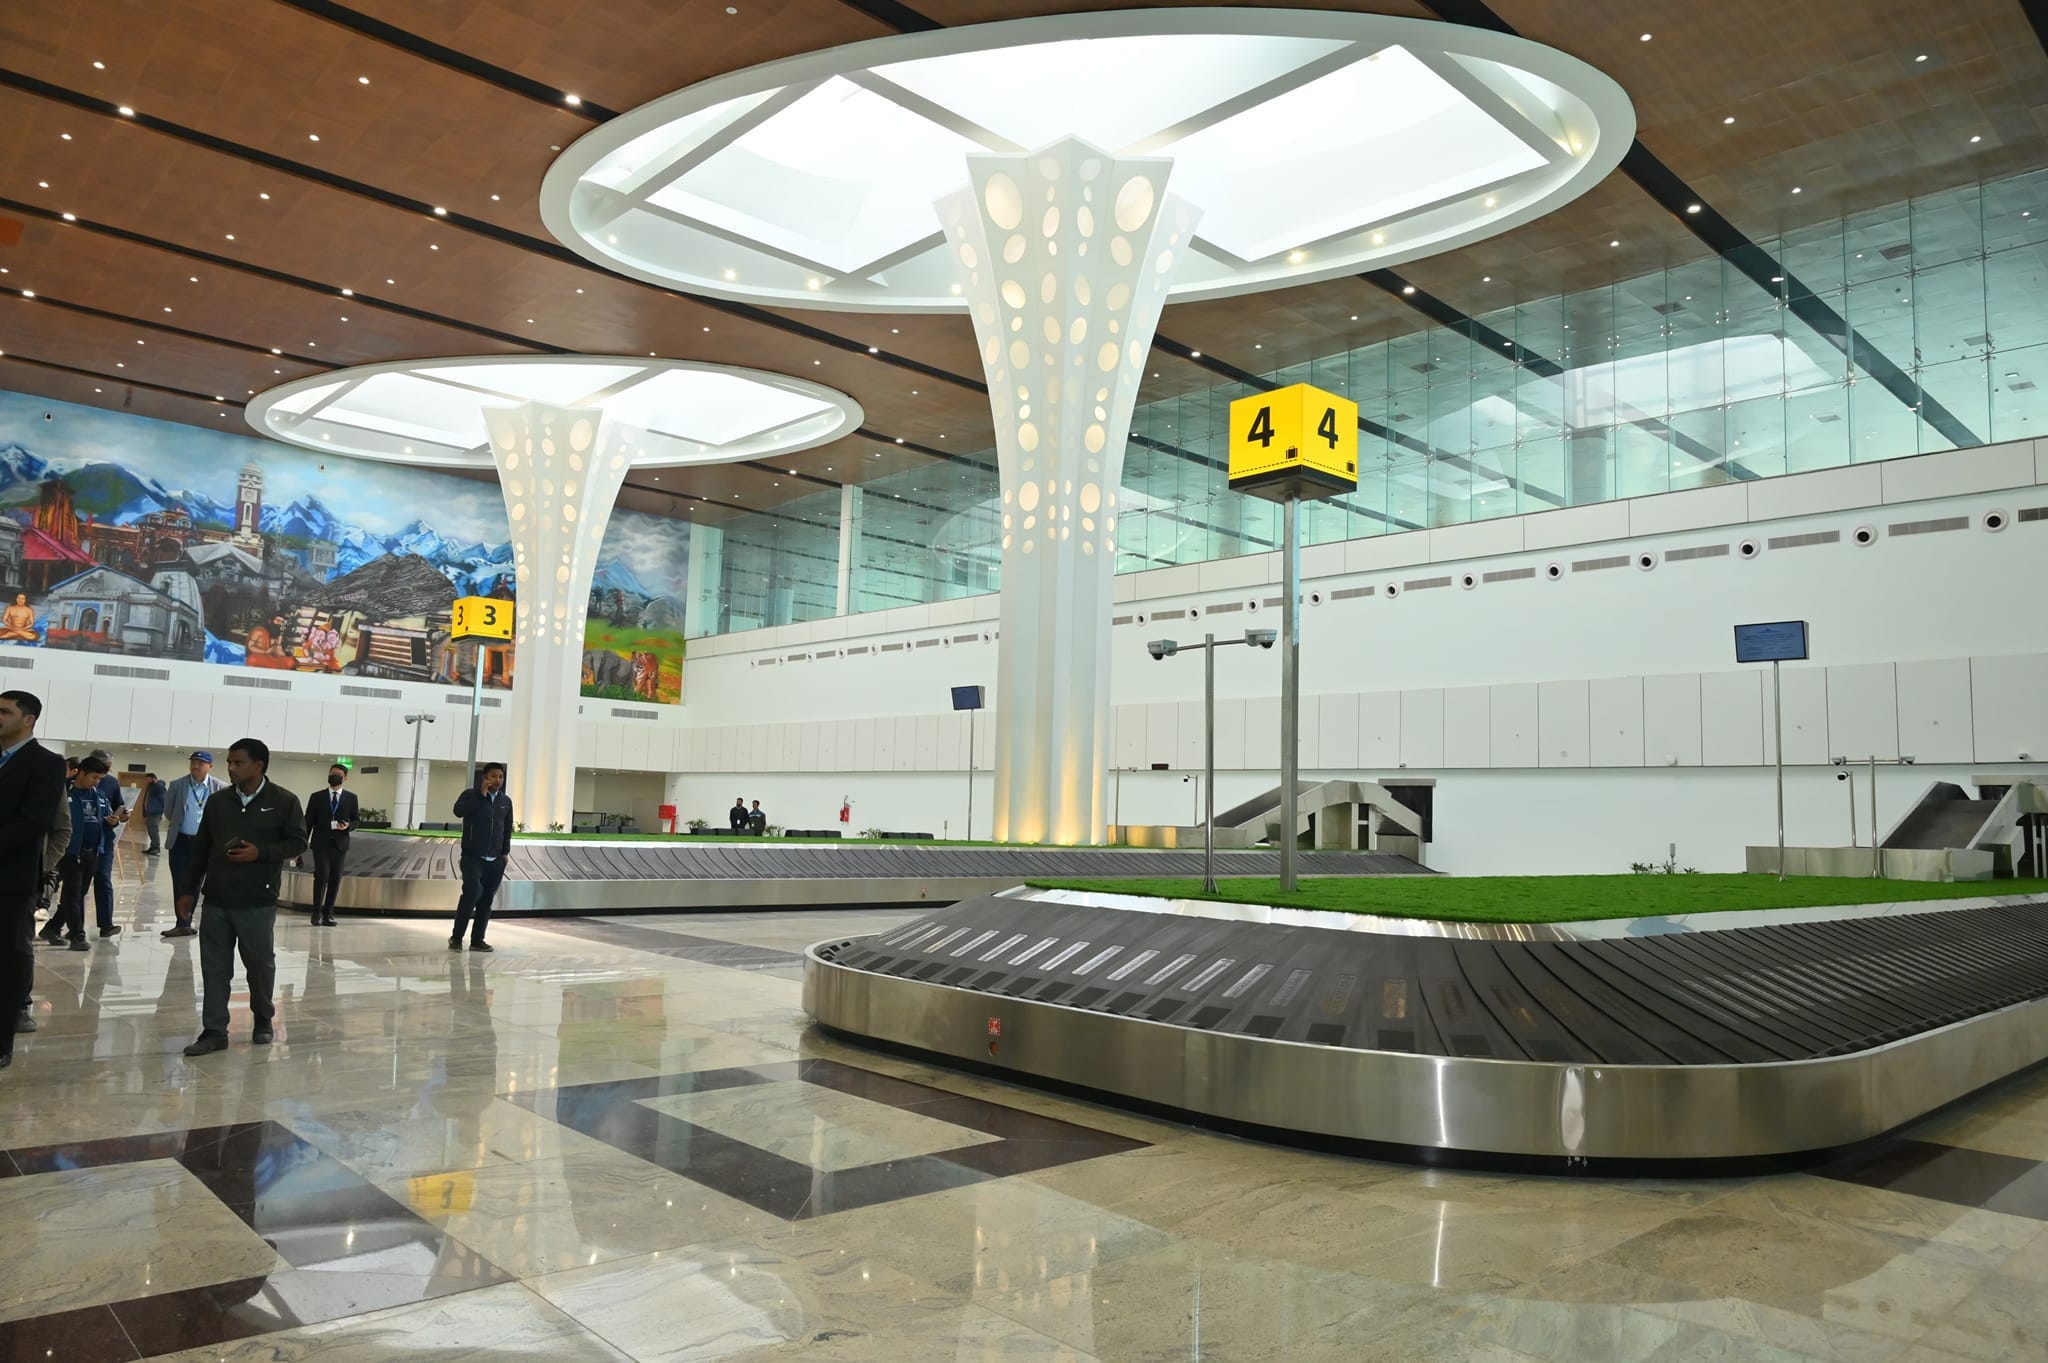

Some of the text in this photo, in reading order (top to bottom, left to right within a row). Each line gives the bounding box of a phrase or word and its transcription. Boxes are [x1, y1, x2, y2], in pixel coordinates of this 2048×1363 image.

[1247, 406, 1275, 448] 4
[1317, 407, 1339, 450] 4
[457, 605, 464, 626] 3
[483, 605, 497, 626] 3
